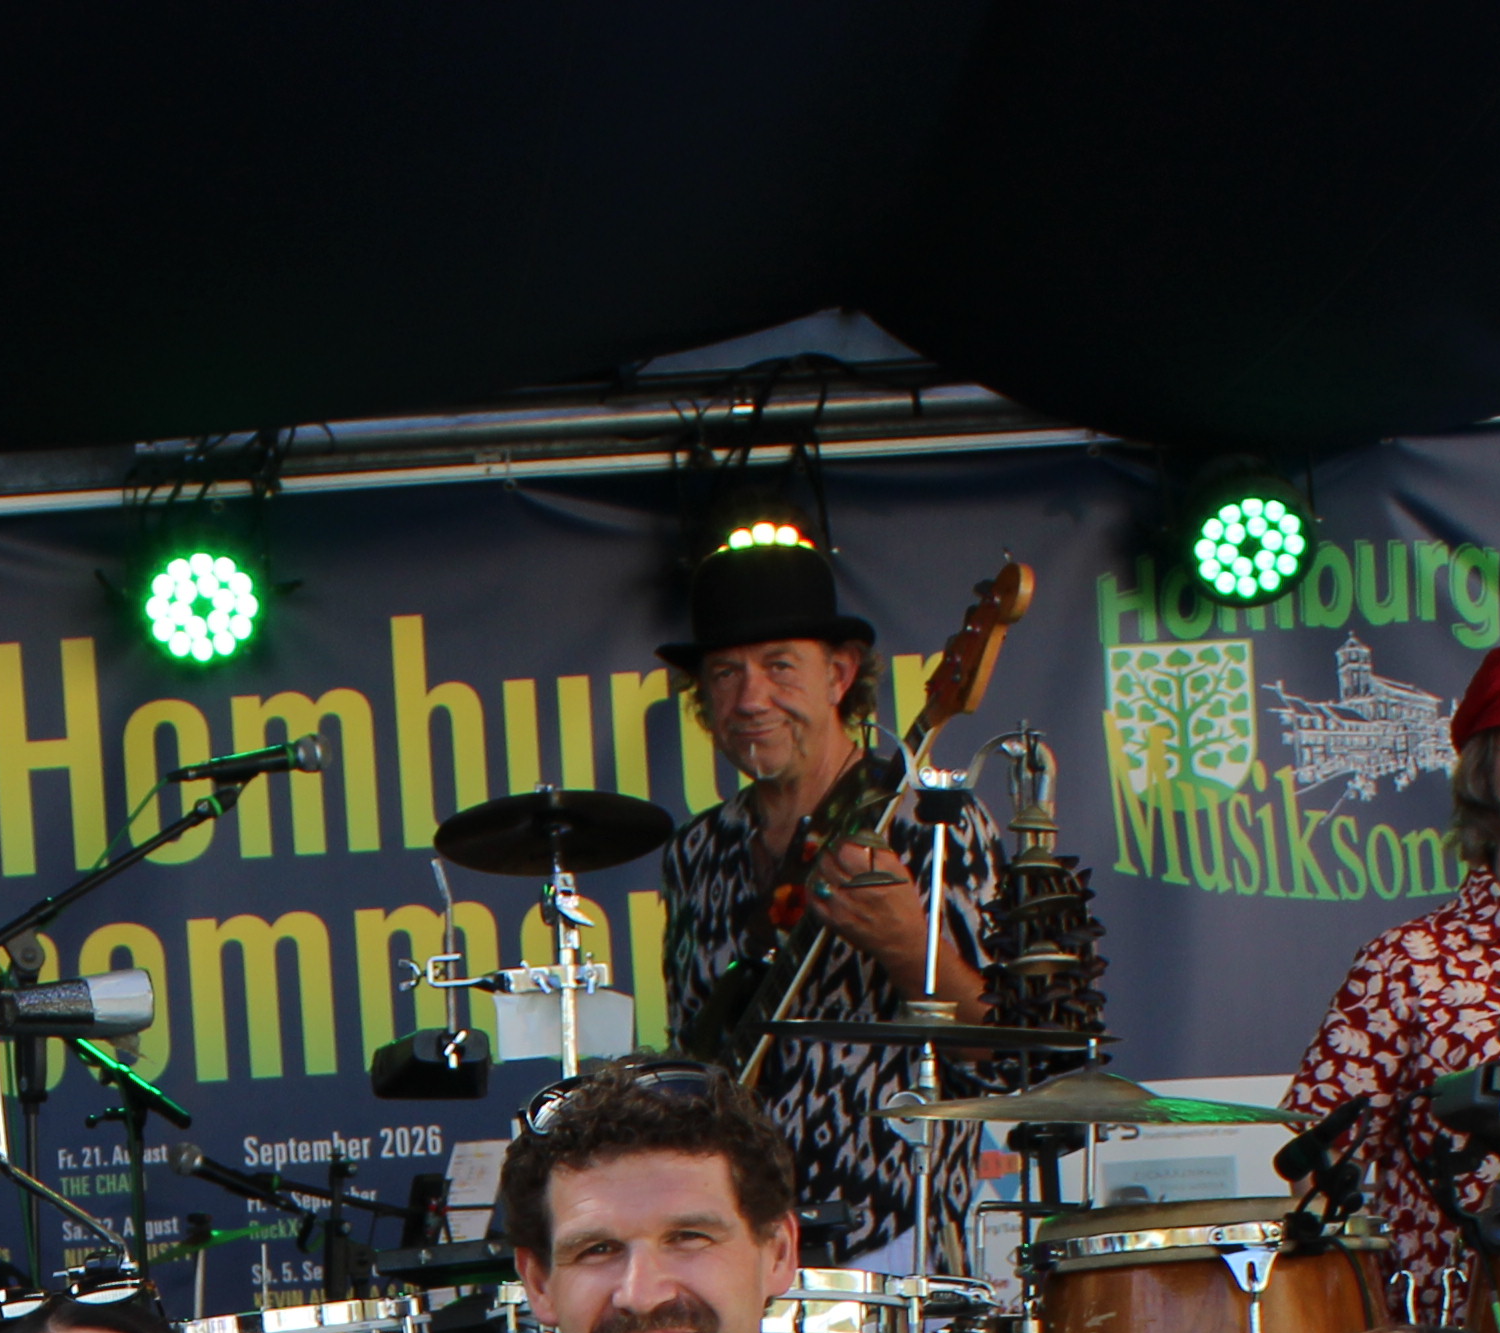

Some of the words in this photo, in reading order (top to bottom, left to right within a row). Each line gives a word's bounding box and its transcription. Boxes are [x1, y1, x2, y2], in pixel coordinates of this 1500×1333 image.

[57, 1149, 77, 1170] Fr.
[82, 1146, 108, 1168] 21.
[243, 1130, 373, 1172] September
[379, 1124, 444, 1159] 2026
[60, 1174, 91, 1198] THE
[62, 1219, 88, 1242] Sa.
[122, 1216, 180, 1241] Agust
